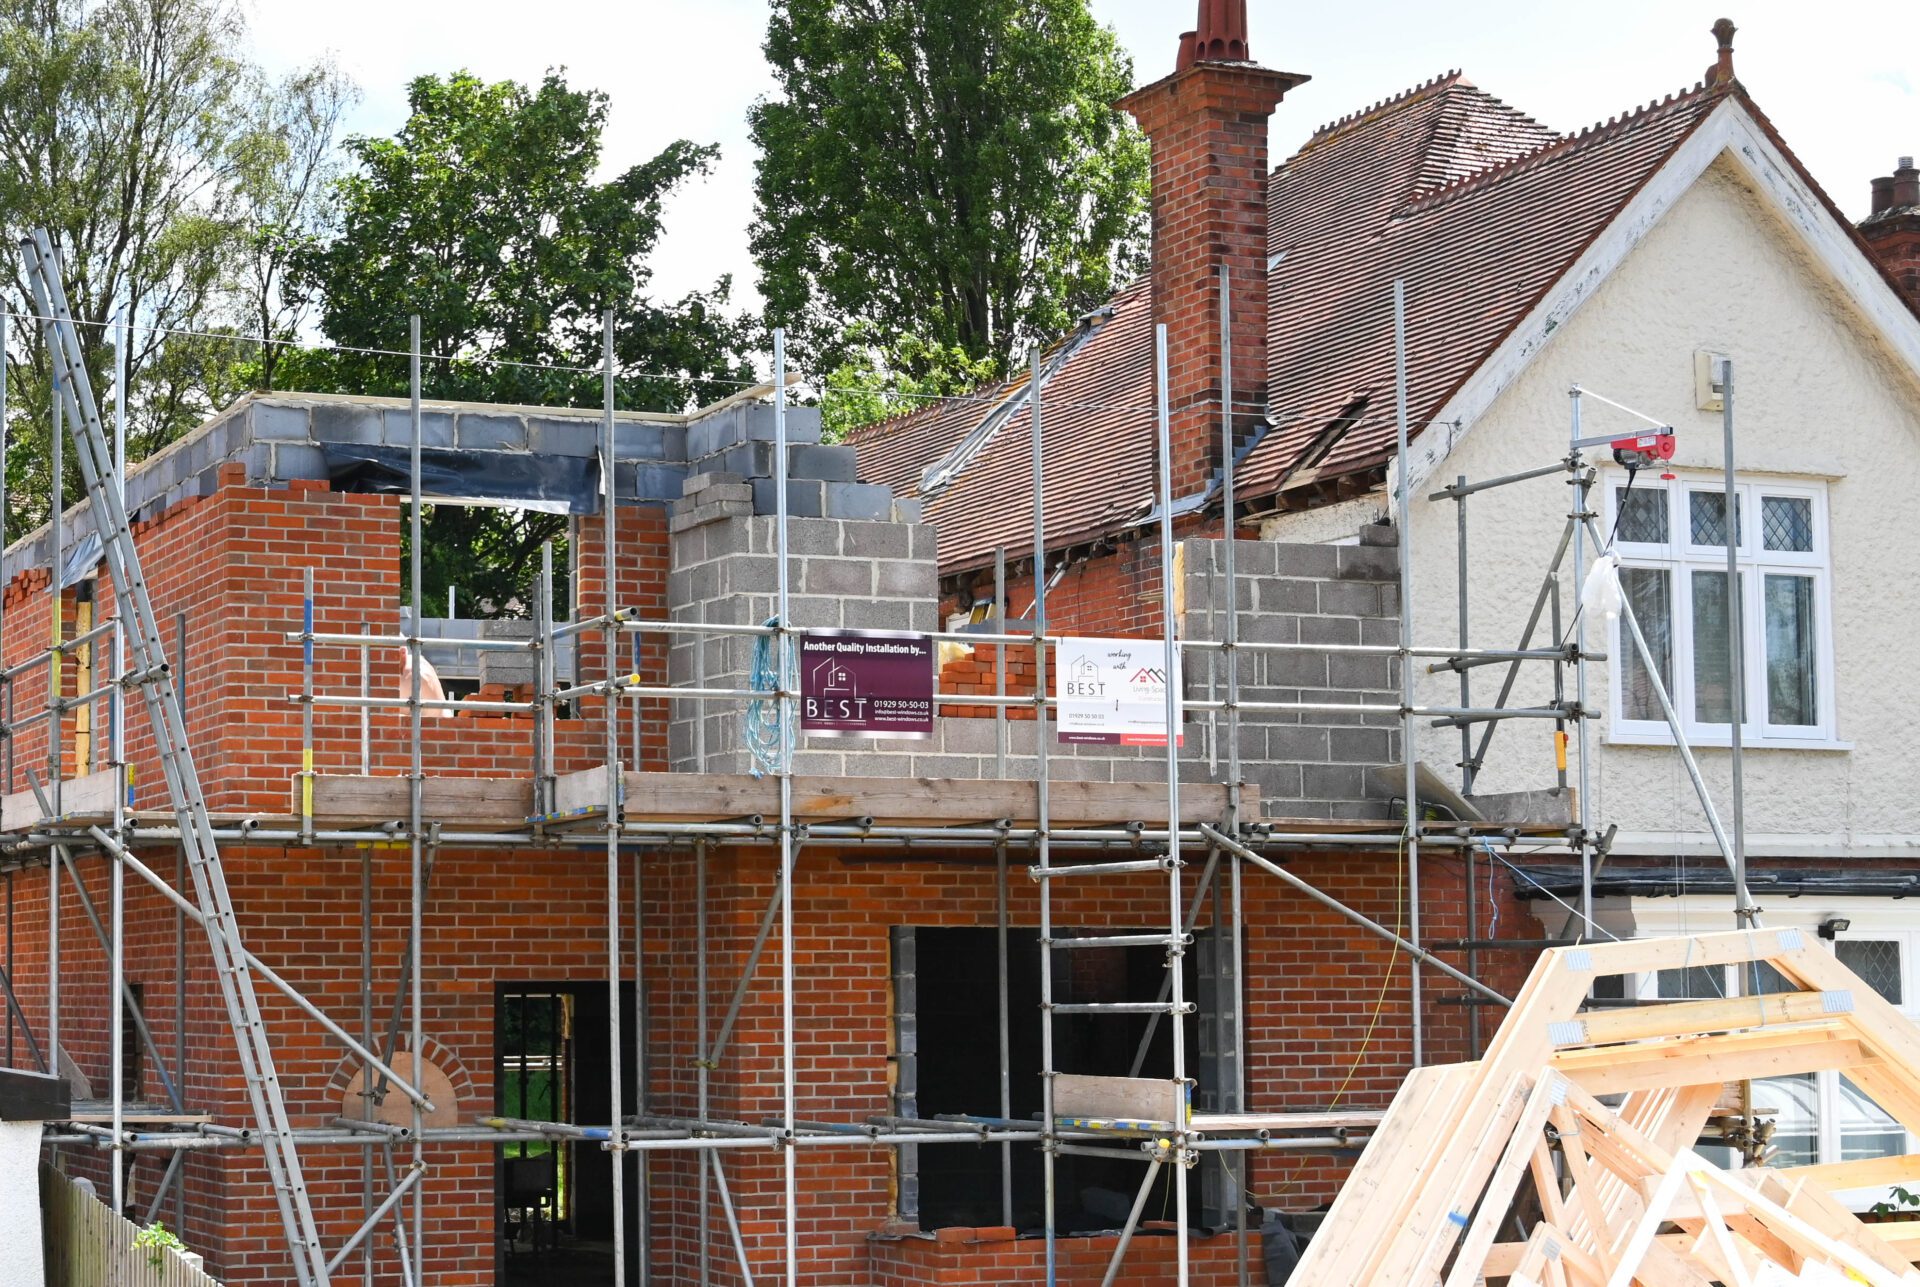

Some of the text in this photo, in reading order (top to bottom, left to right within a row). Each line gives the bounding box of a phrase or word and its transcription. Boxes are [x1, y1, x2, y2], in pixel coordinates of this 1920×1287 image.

[804, 641, 927, 656] Another Quality Installation by...
[1108, 649, 1131, 661] working
[1113, 661, 1126, 670] with
[1067, 682, 1106, 695] BEST
[806, 700, 867, 719] BEST
[874, 700, 929, 709] 01929 50-50-03
